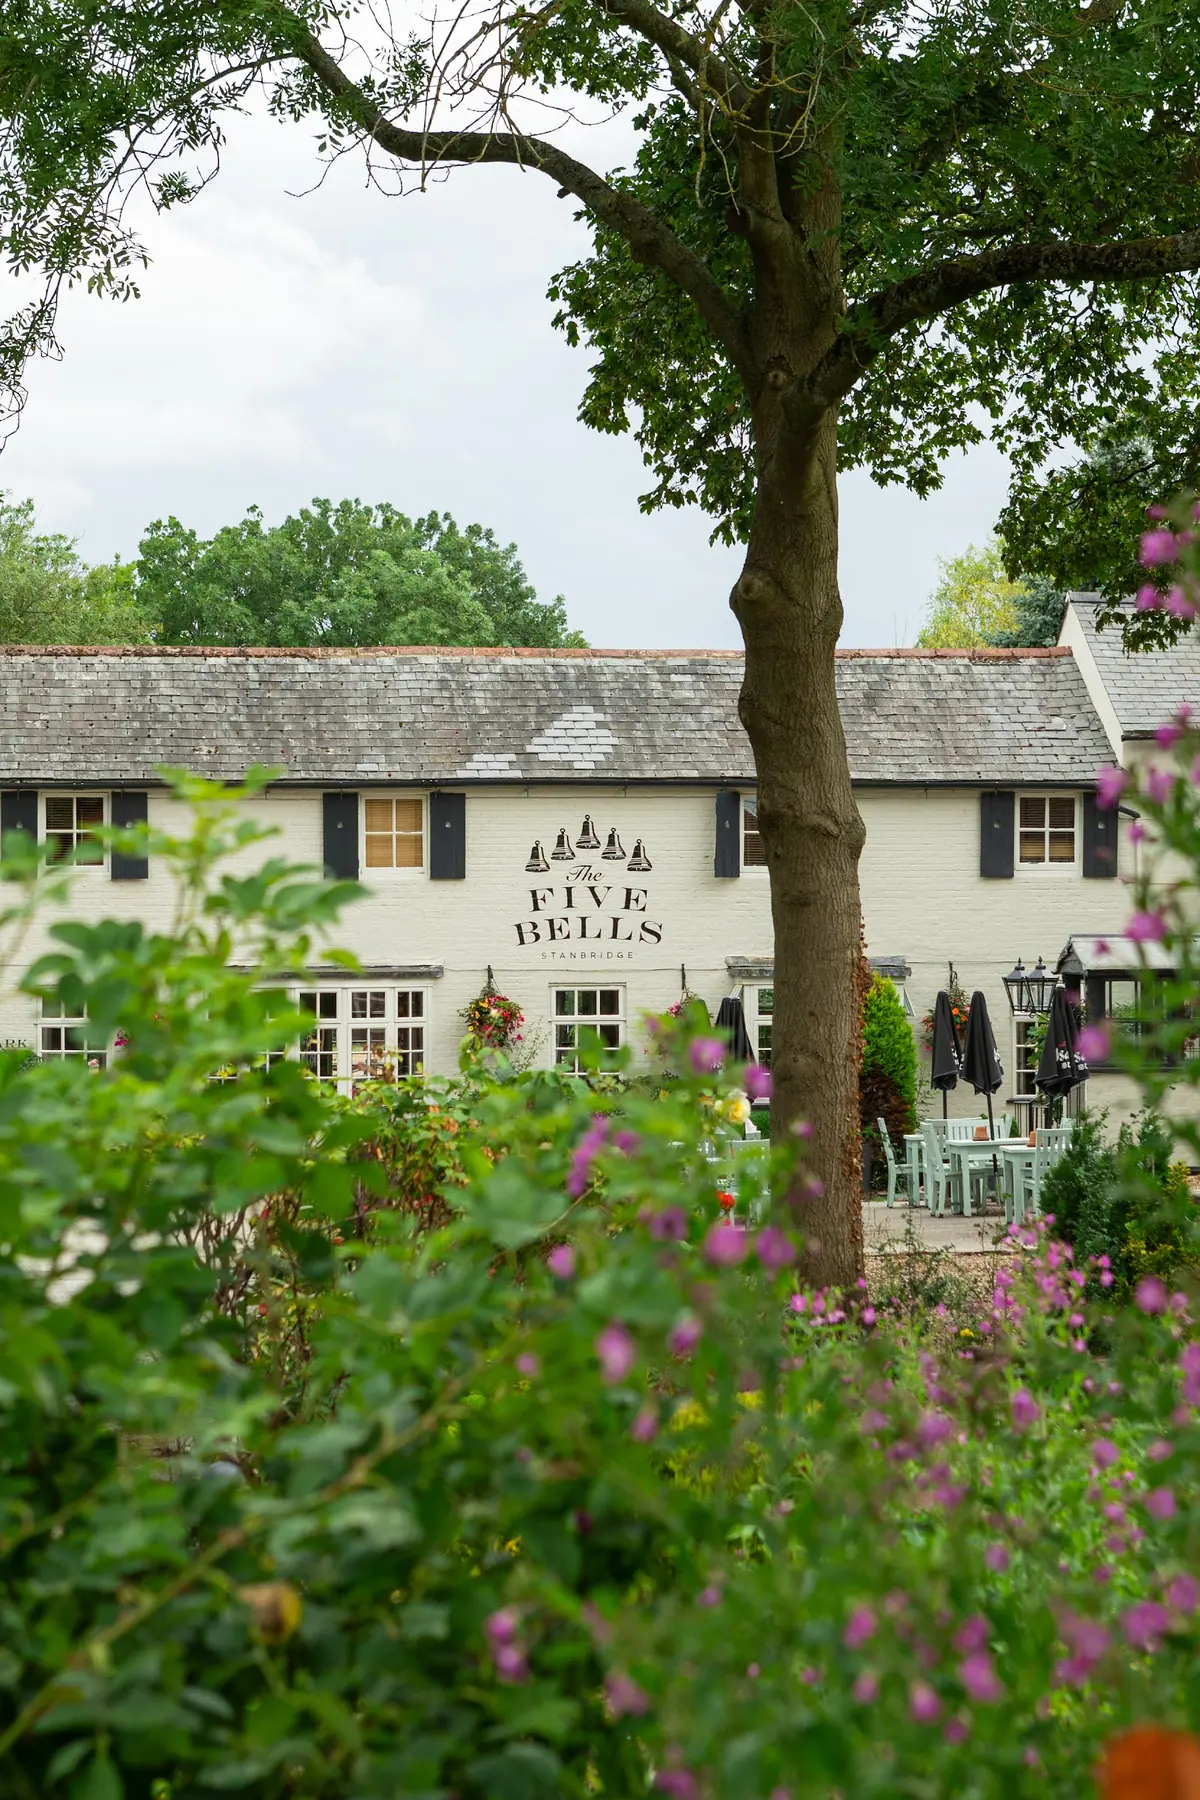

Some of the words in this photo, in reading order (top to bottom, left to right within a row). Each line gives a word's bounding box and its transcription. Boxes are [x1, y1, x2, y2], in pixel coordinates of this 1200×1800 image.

[566, 864, 604, 882] The
[529, 886, 648, 912] FIVE
[512, 916, 663, 946] BELLS
[541, 951, 634, 959] STANBRIDGE
[0, 1039, 27, 1048] RK
